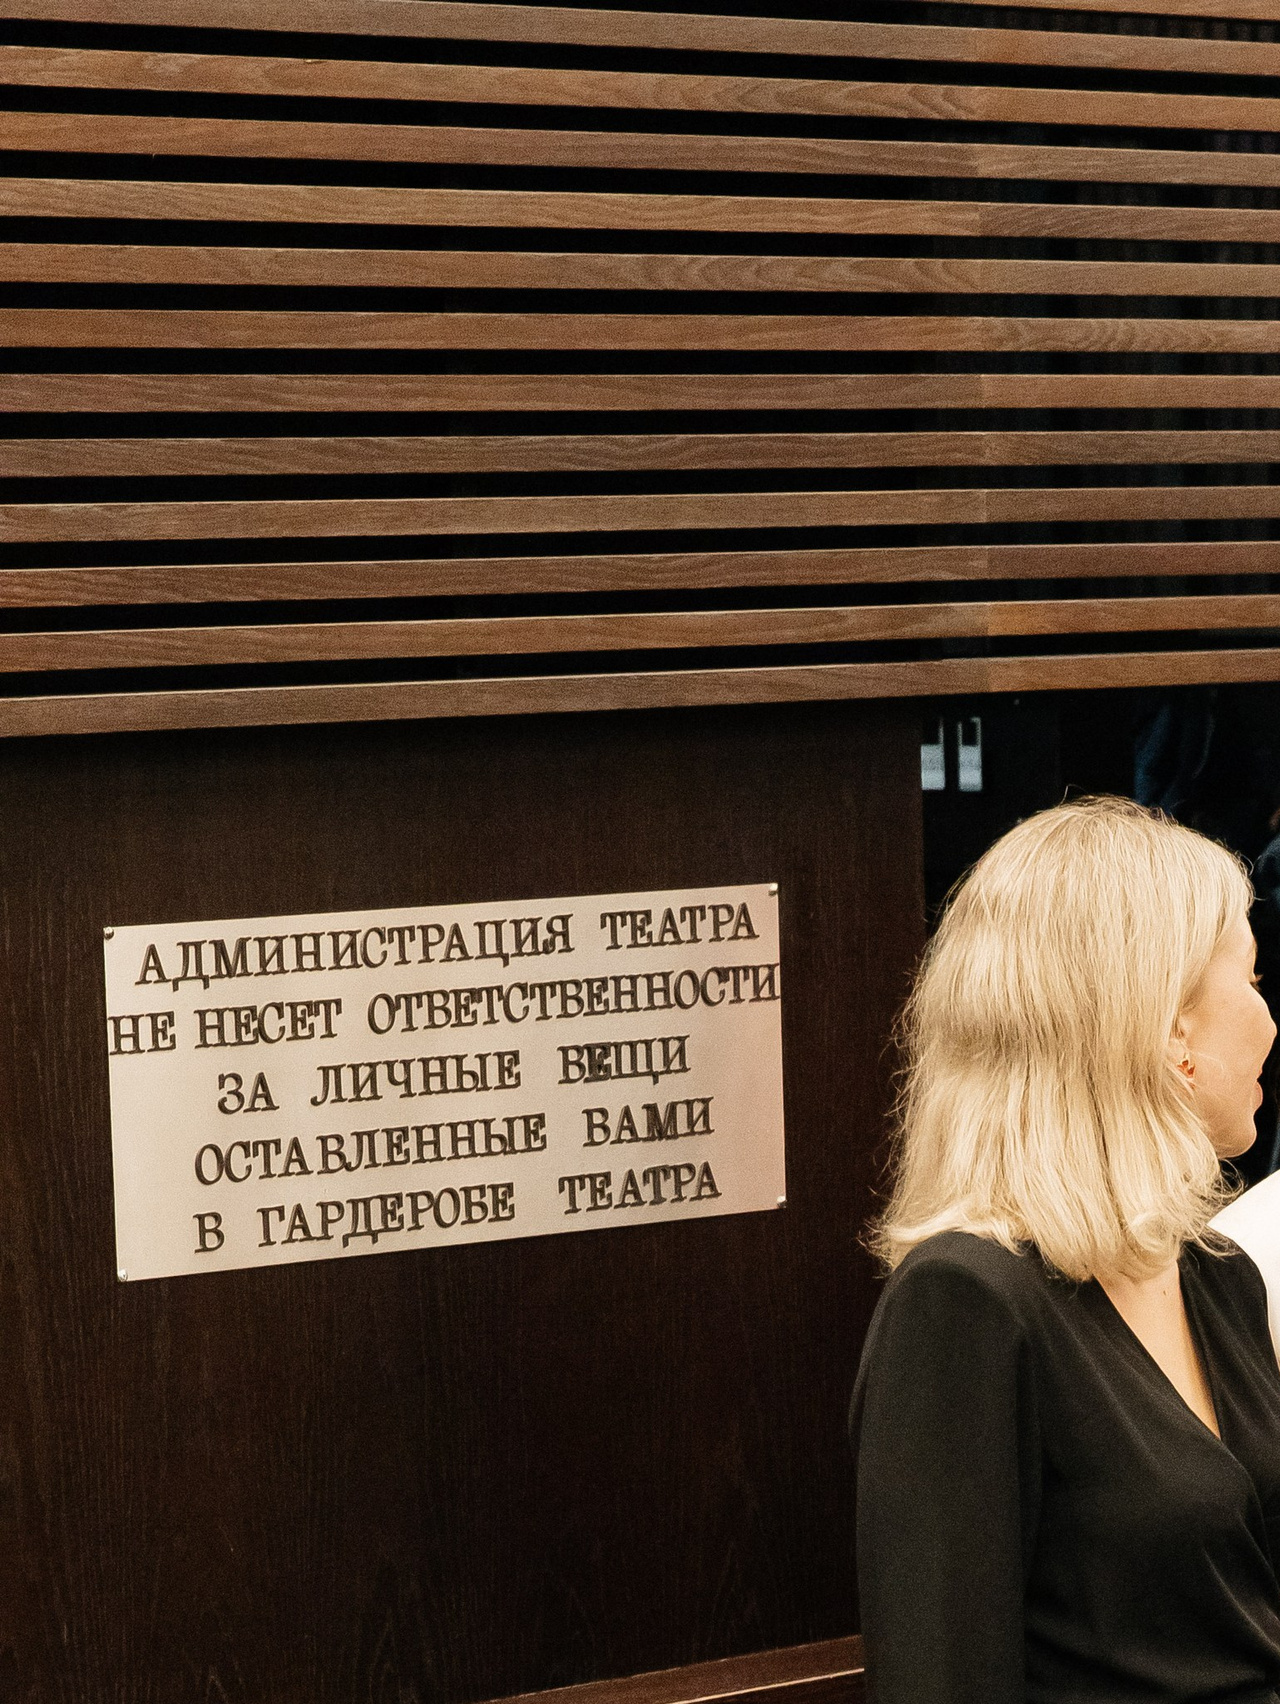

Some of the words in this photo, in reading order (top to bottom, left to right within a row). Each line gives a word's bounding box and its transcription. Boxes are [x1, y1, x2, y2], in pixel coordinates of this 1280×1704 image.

[136, 915, 574, 991] АДМИНИСТРАЦИЯ
[601, 903, 759, 950] ТЕАТРА
[109, 1012, 175, 1055] НЕ
[195, 999, 341, 1048] НЕСЕТ
[368, 963, 781, 1034] ОТВЕТСТВЕННОСТИ
[218, 1073, 279, 1114] ЗА
[311, 1051, 520, 1106] ЛИЧНЫЕ
[558, 1036, 690, 1084] ВЕЩИ
[195, 1113, 546, 1185] ОСТАВЛЕННЫЕ
[582, 1097, 714, 1147] ВАМИ
[194, 1213, 224, 1253] В
[258, 1183, 514, 1247] ГАРДЕРОБЕ
[559, 1162, 721, 1214] ТЕАТРА
